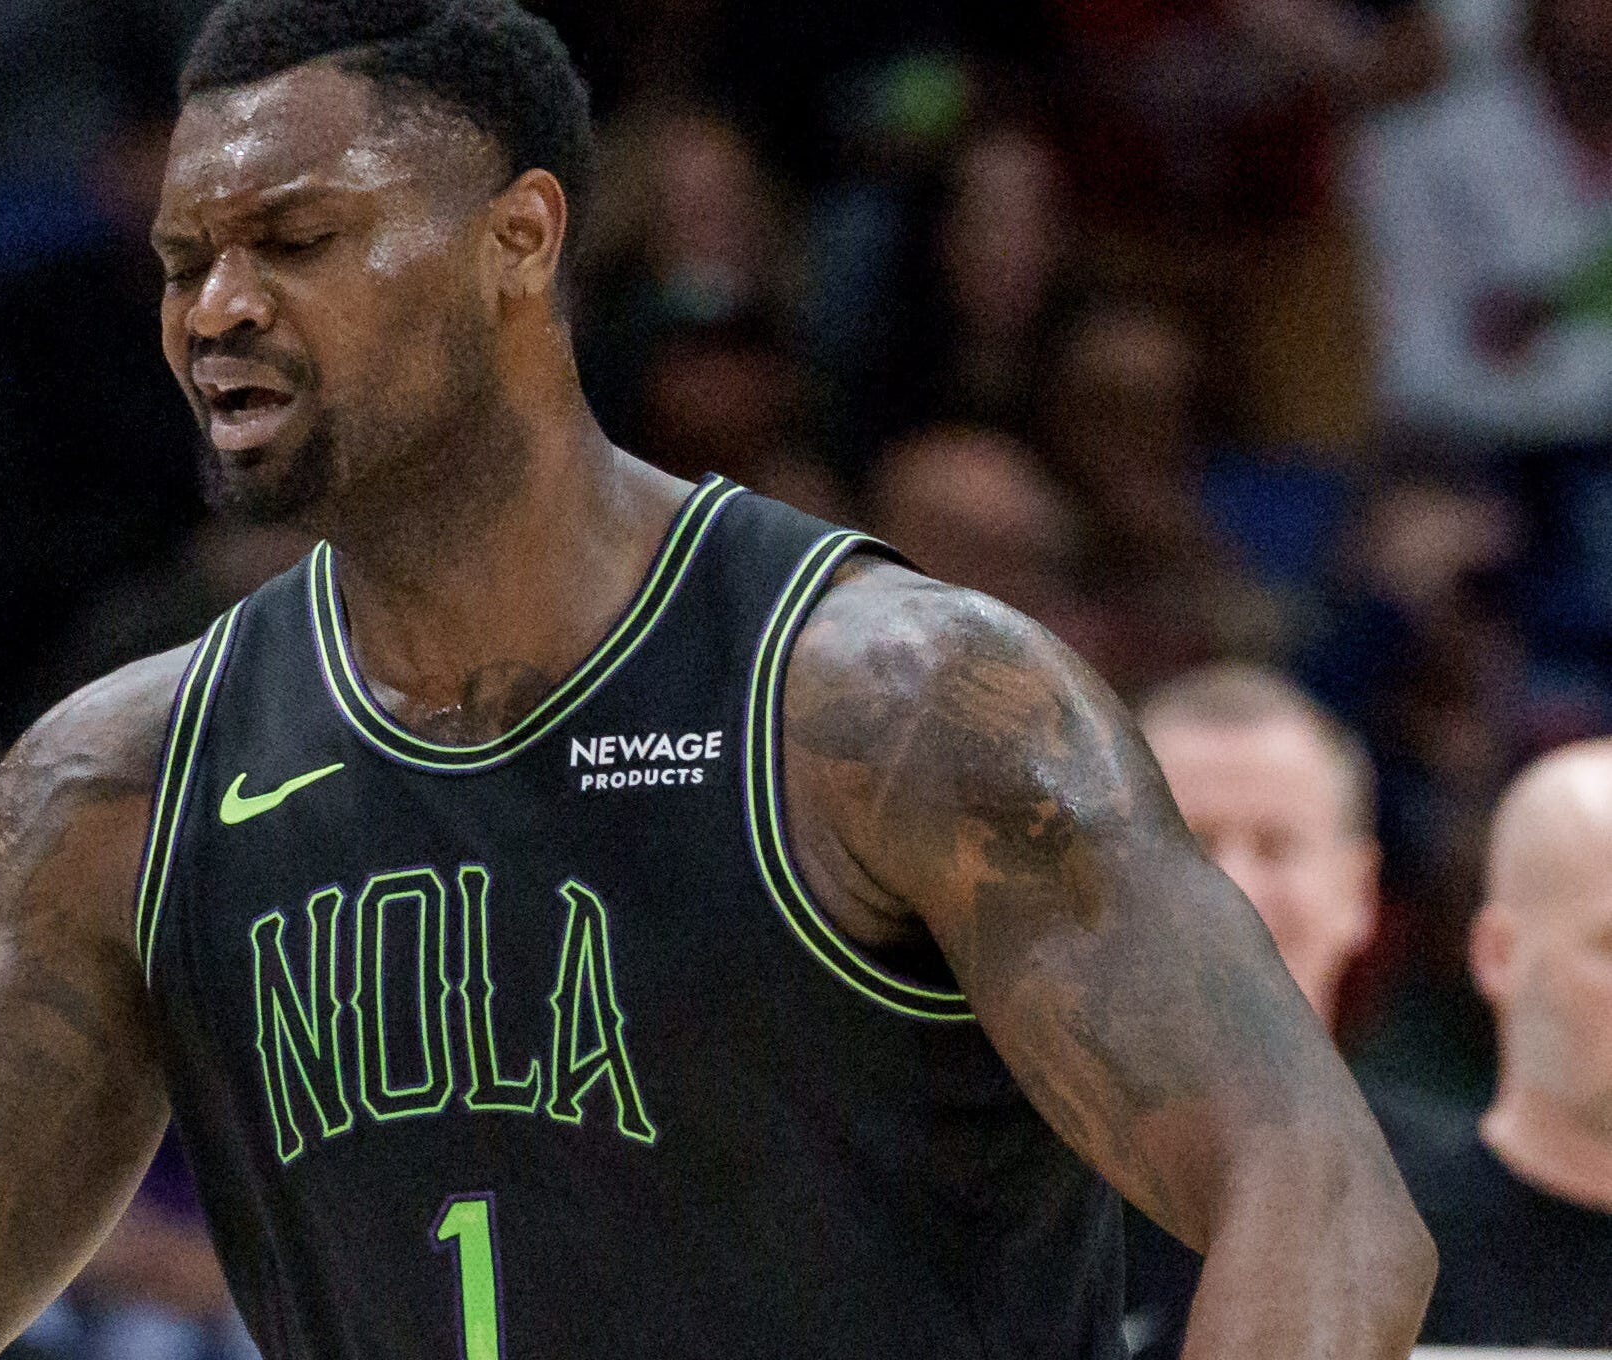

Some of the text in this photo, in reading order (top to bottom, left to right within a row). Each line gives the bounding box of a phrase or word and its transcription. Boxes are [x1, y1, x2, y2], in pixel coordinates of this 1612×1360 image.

[570, 730, 723, 767] NEWAGE
[581, 768, 704, 791] PRODUCTS
[251, 865, 656, 1163] NOLA
